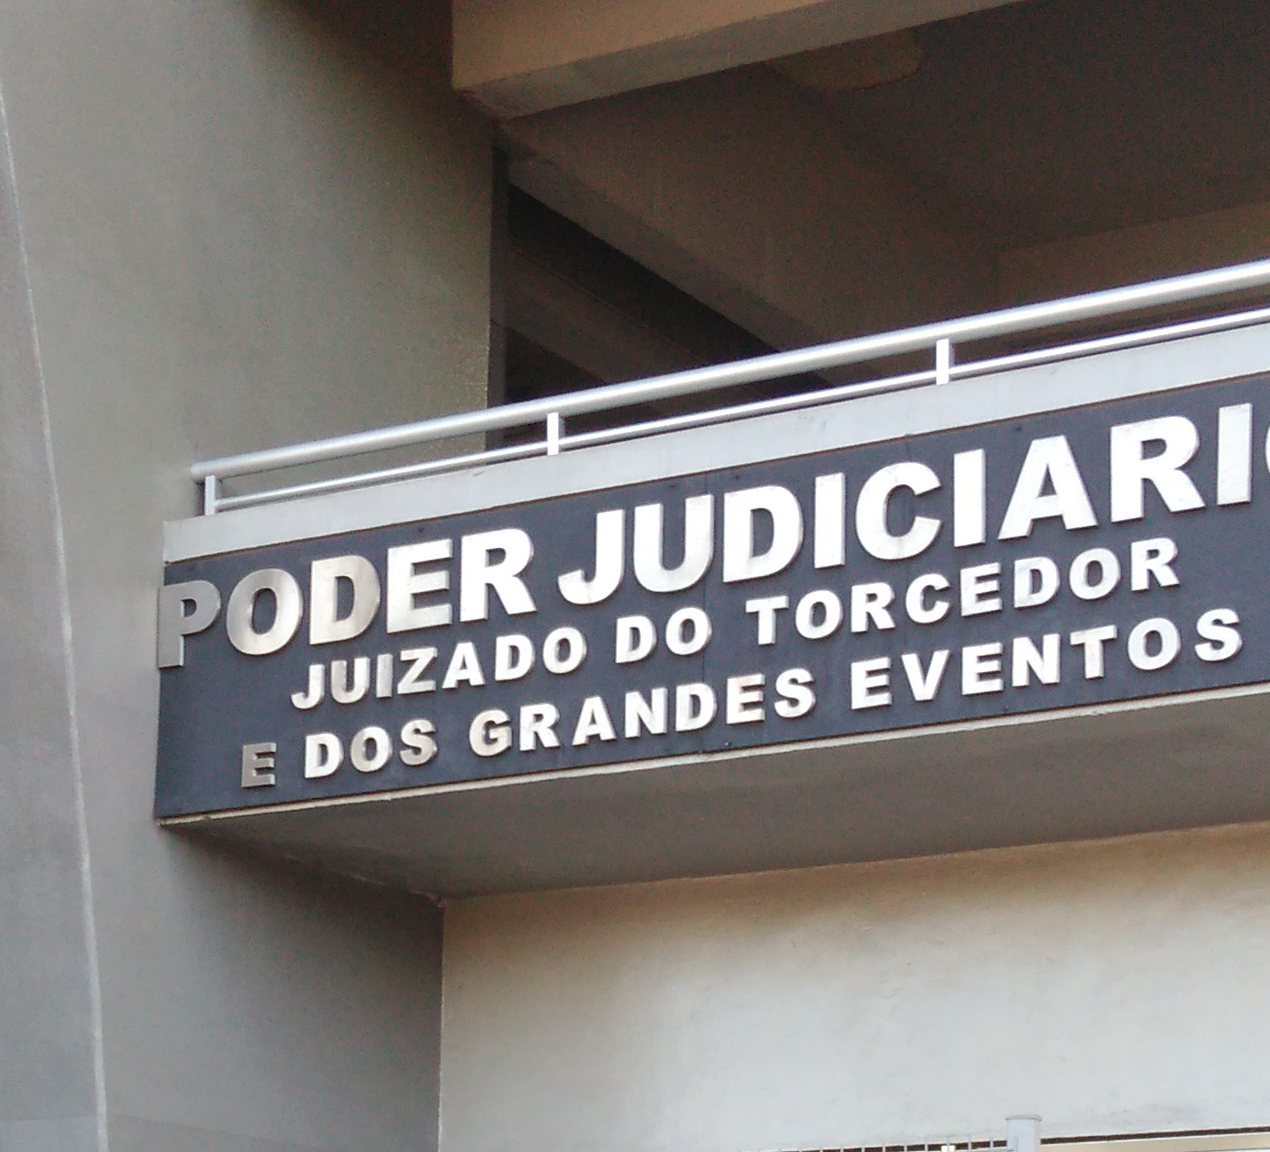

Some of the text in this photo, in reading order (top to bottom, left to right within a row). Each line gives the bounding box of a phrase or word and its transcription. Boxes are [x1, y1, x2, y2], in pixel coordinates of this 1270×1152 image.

[158, 527, 535, 668] PODER
[290, 535, 1182, 711] JUIZADO DO TORCEDOR
[240, 605, 1245, 788] E DOS GRANDES EVENTOS
